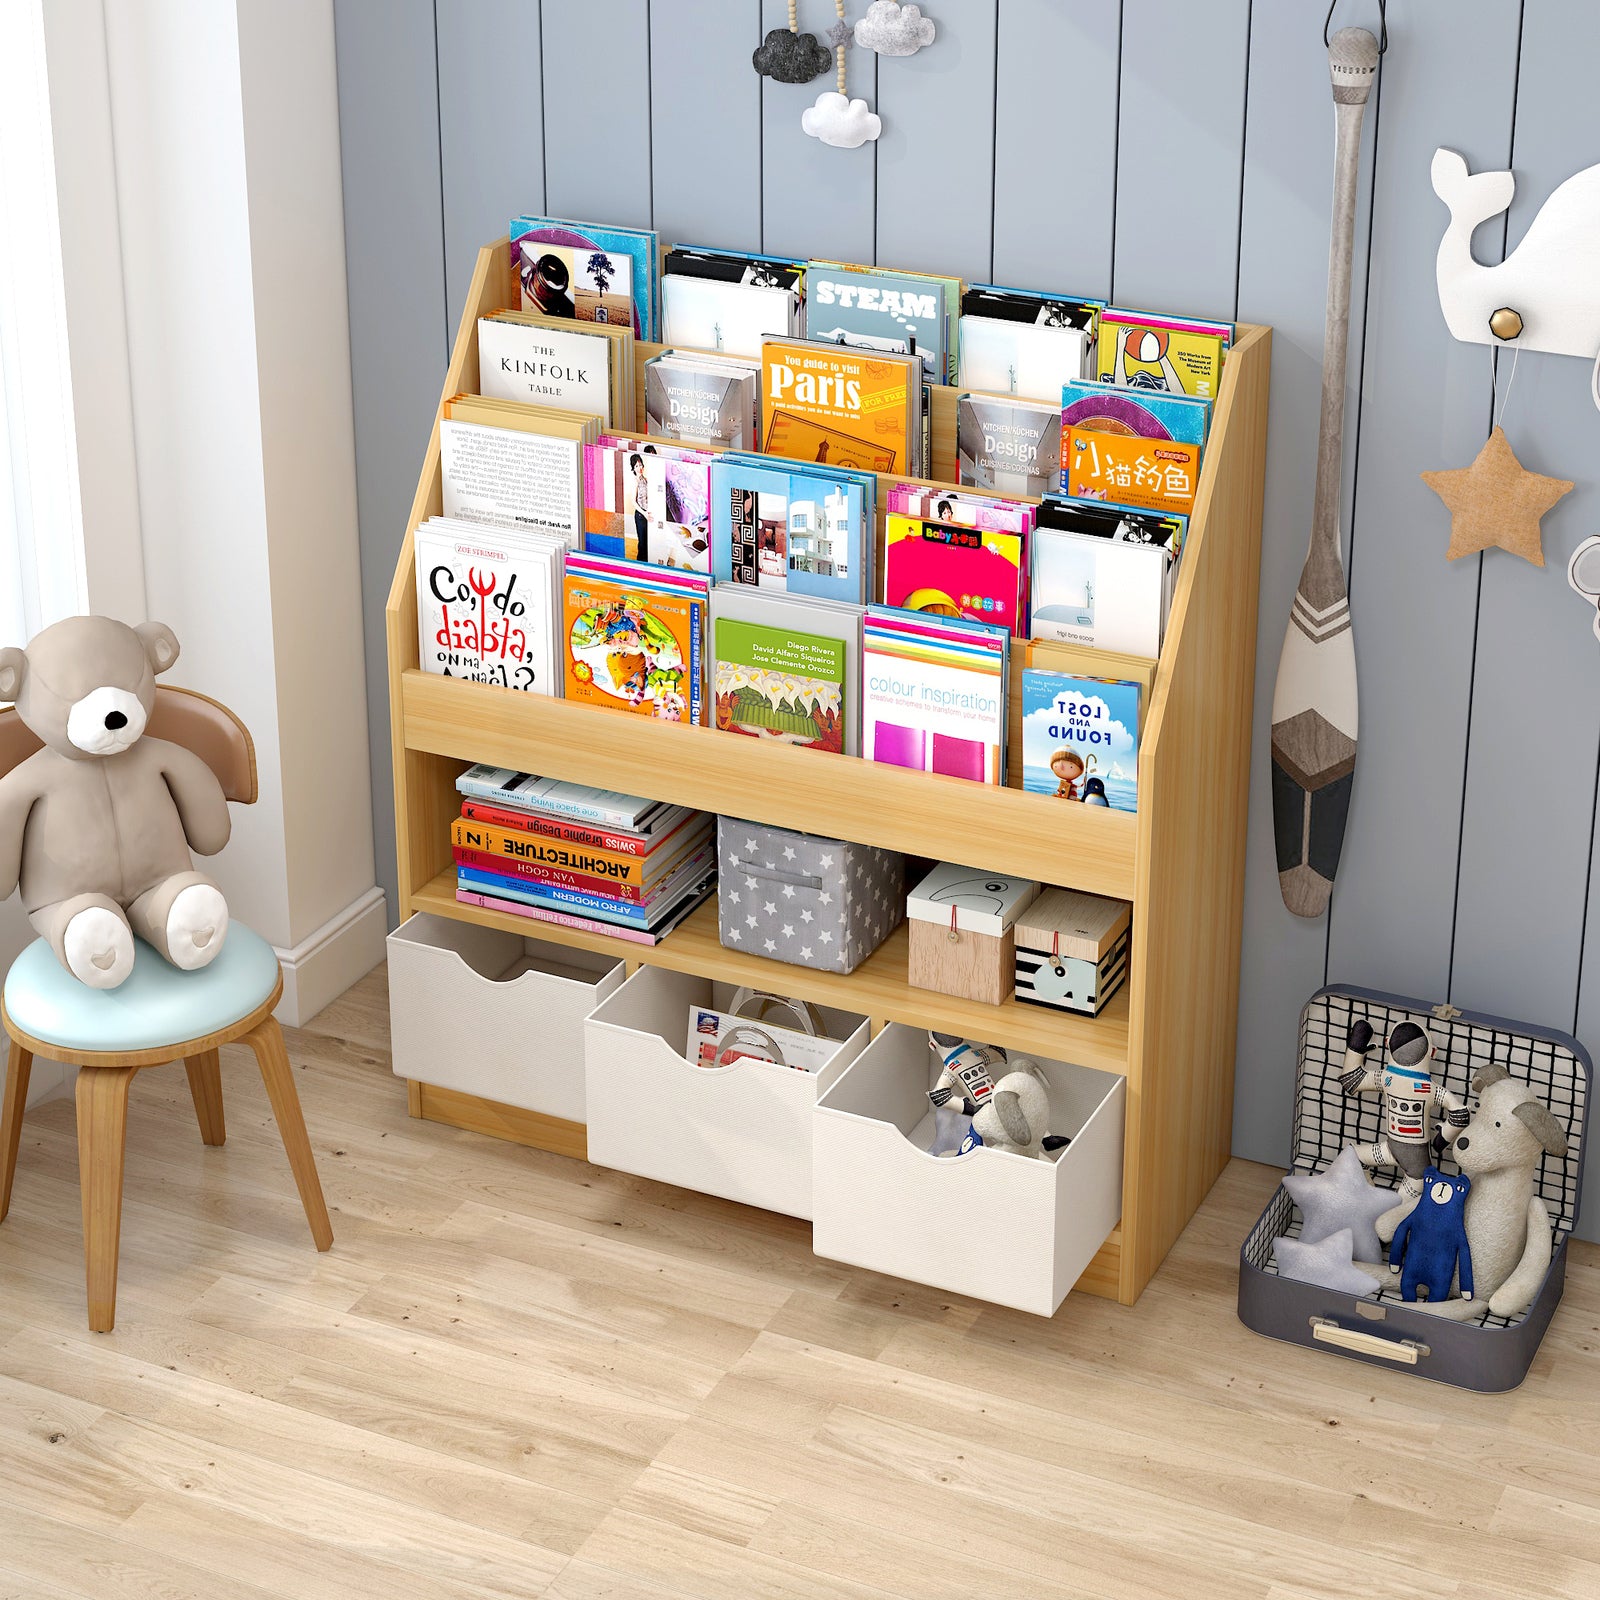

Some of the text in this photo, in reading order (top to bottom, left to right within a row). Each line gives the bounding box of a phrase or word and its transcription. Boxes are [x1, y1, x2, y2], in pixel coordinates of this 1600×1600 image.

[816, 281, 936, 319] STEAM
[533, 346, 555, 356] THE
[501, 358, 588, 384] KINFOLK
[785, 355, 860, 374] You guide to visit
[528, 384, 562, 396] TABLE
[770, 364, 860, 410] Paris
[864, 394, 883, 408] FOR
[670, 399, 718, 425] Design
[983, 423, 1039, 438] KITCHEN/KÜCHEN
[985, 435, 1036, 462] Design
[1075, 441, 1192, 498] 小猫钓鱼
[926, 528, 951, 543] Baby
[473, 548, 505, 560] STRIMPEL
[430, 566, 476, 610] Co,
[493, 574, 524, 616] do
[753, 644, 835, 666] David Alfaro Siqueiros
[788, 641, 834, 656] Diego Rivera
[752, 654, 834, 675] Jose Clemente Orozco
[870, 676, 996, 712] colour inspiration
[691, 700, 700, 726] new
[870, 693, 996, 723] creative schemes to transform your home
[530, 796, 598, 817] one space living
[527, 820, 635, 854] Swiss Graphic Design
[504, 839, 630, 878] ARCHITECTURE
[517, 864, 549, 877] GOGH
[553, 871, 575, 884] VAN
[552, 891, 631, 914] AFRO MODERN
[532, 910, 558, 923] Fellini
[559, 915, 592, 930] Federico
